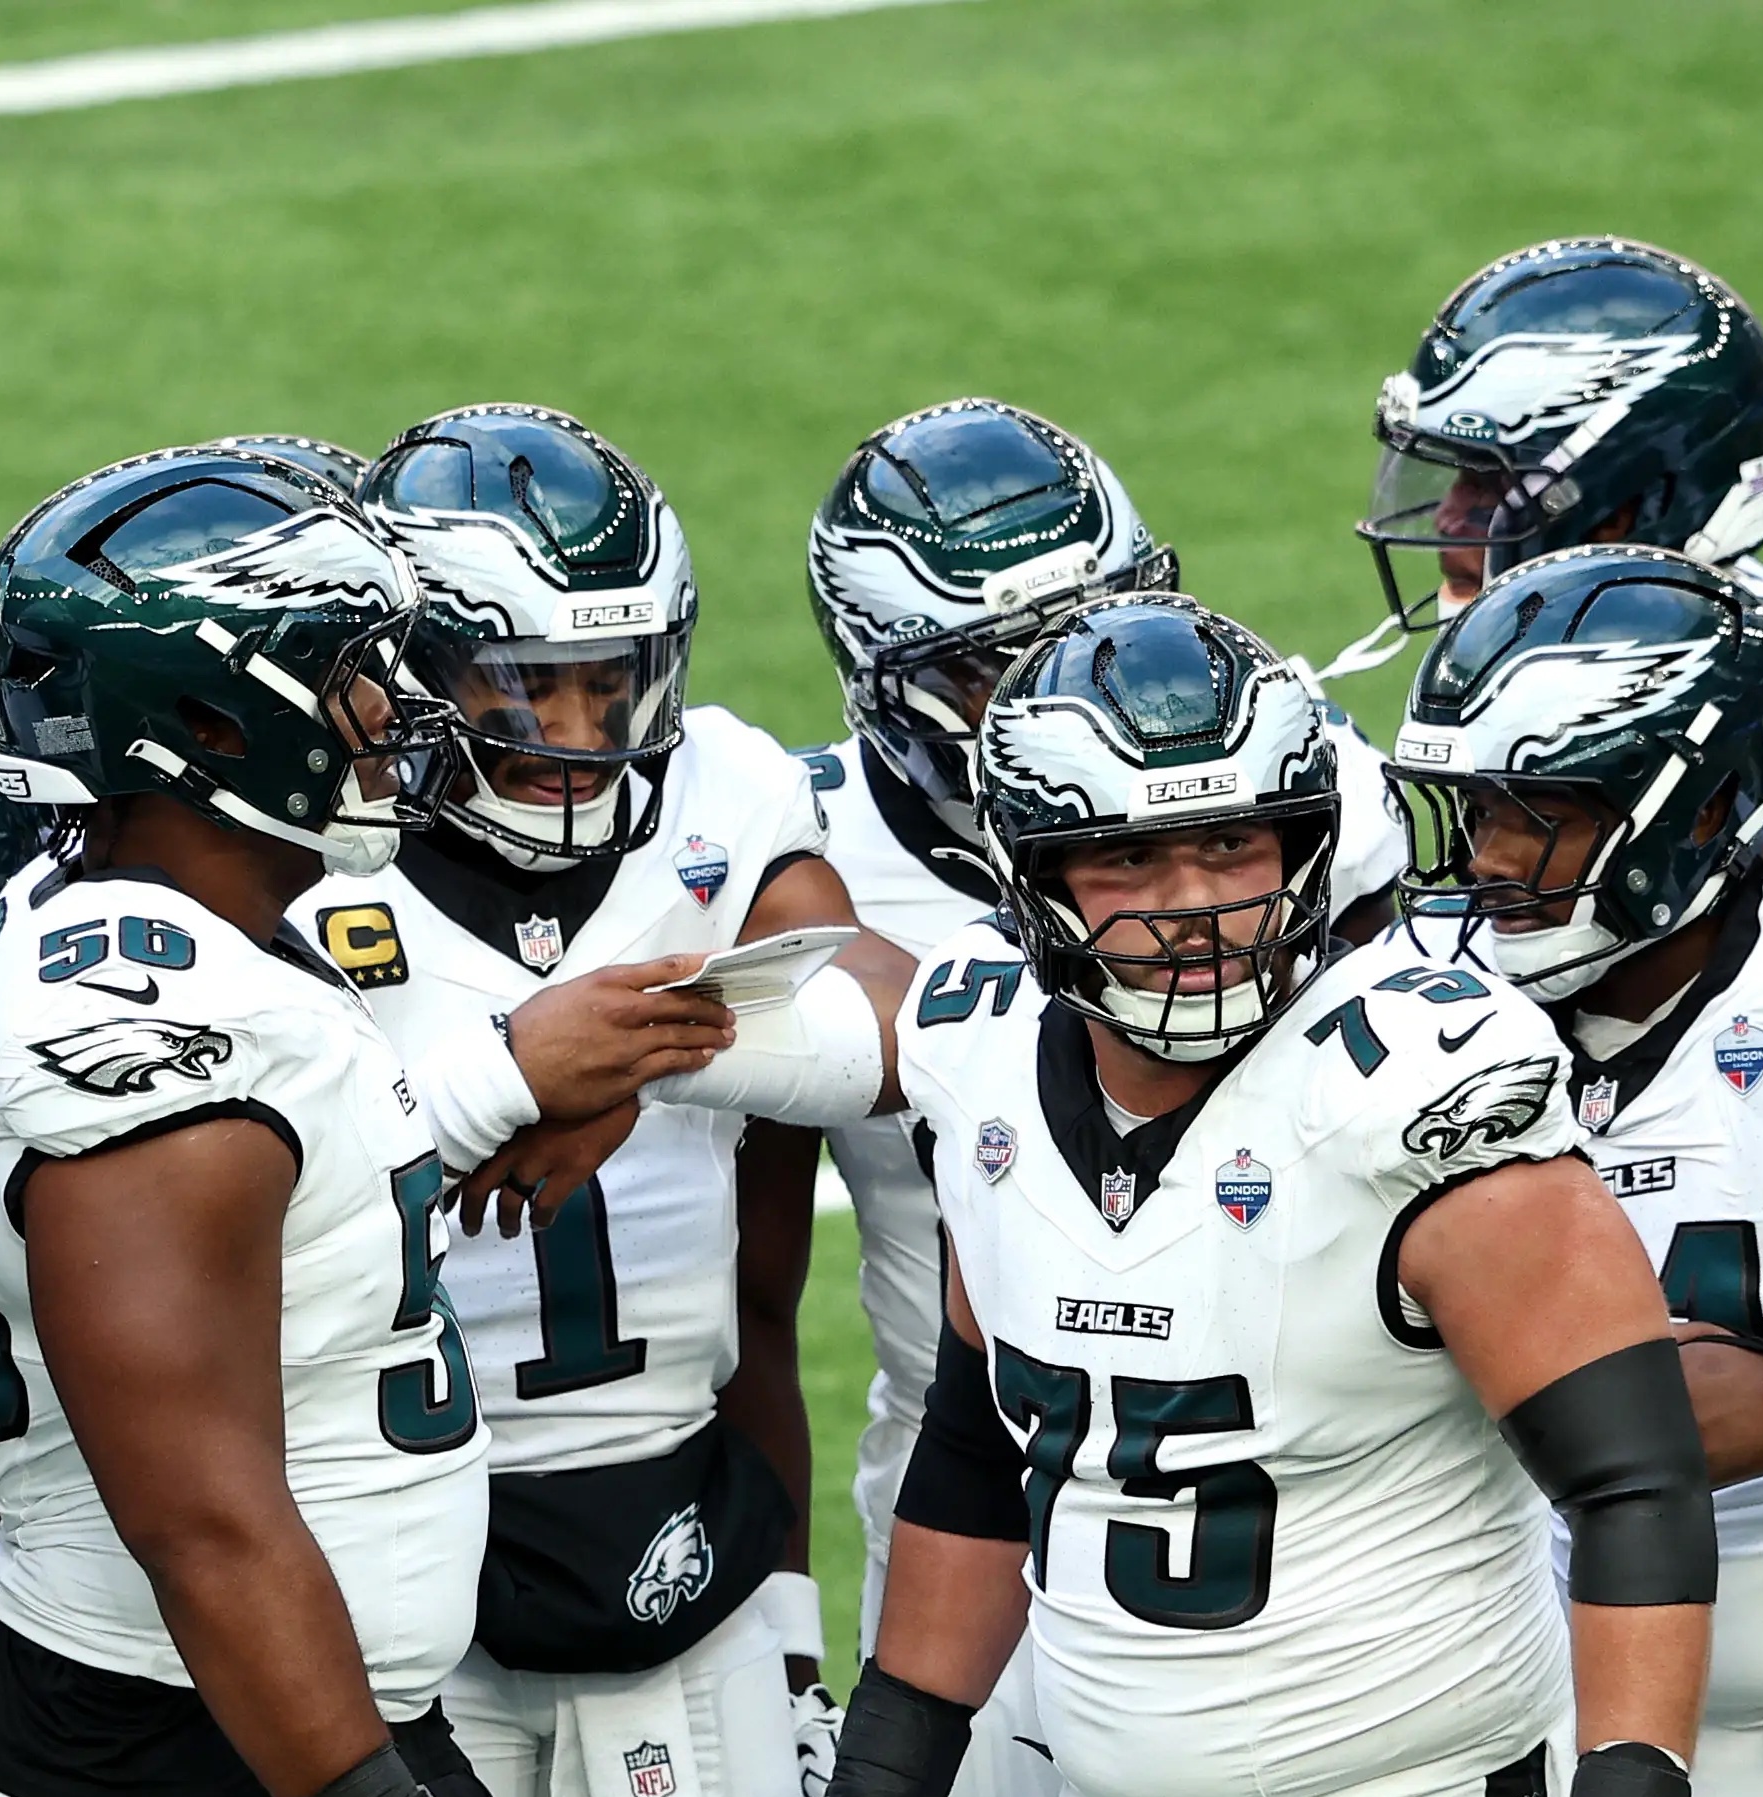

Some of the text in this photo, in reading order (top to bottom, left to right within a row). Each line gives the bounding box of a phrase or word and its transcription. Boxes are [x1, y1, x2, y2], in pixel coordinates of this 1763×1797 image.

[573, 602, 653, 629] EAGLES
[1146, 773, 1236, 804] EAGLES
[681, 865, 727, 881] LONDON
[39, 917, 196, 984] 56
[326, 908, 398, 970] C
[526, 938, 557, 961] NFL
[1303, 965, 1492, 1079] 75
[1583, 1103, 1609, 1122] NFL
[978, 1146, 1011, 1162] DEBUT
[1106, 1192, 1130, 1217] NFL
[1218, 1185, 1269, 1196] LONDON
[1055, 1297, 1174, 1341] EAGLES
[993, 1335, 1278, 1630] 75
[633, 1767, 670, 1797] NFL
